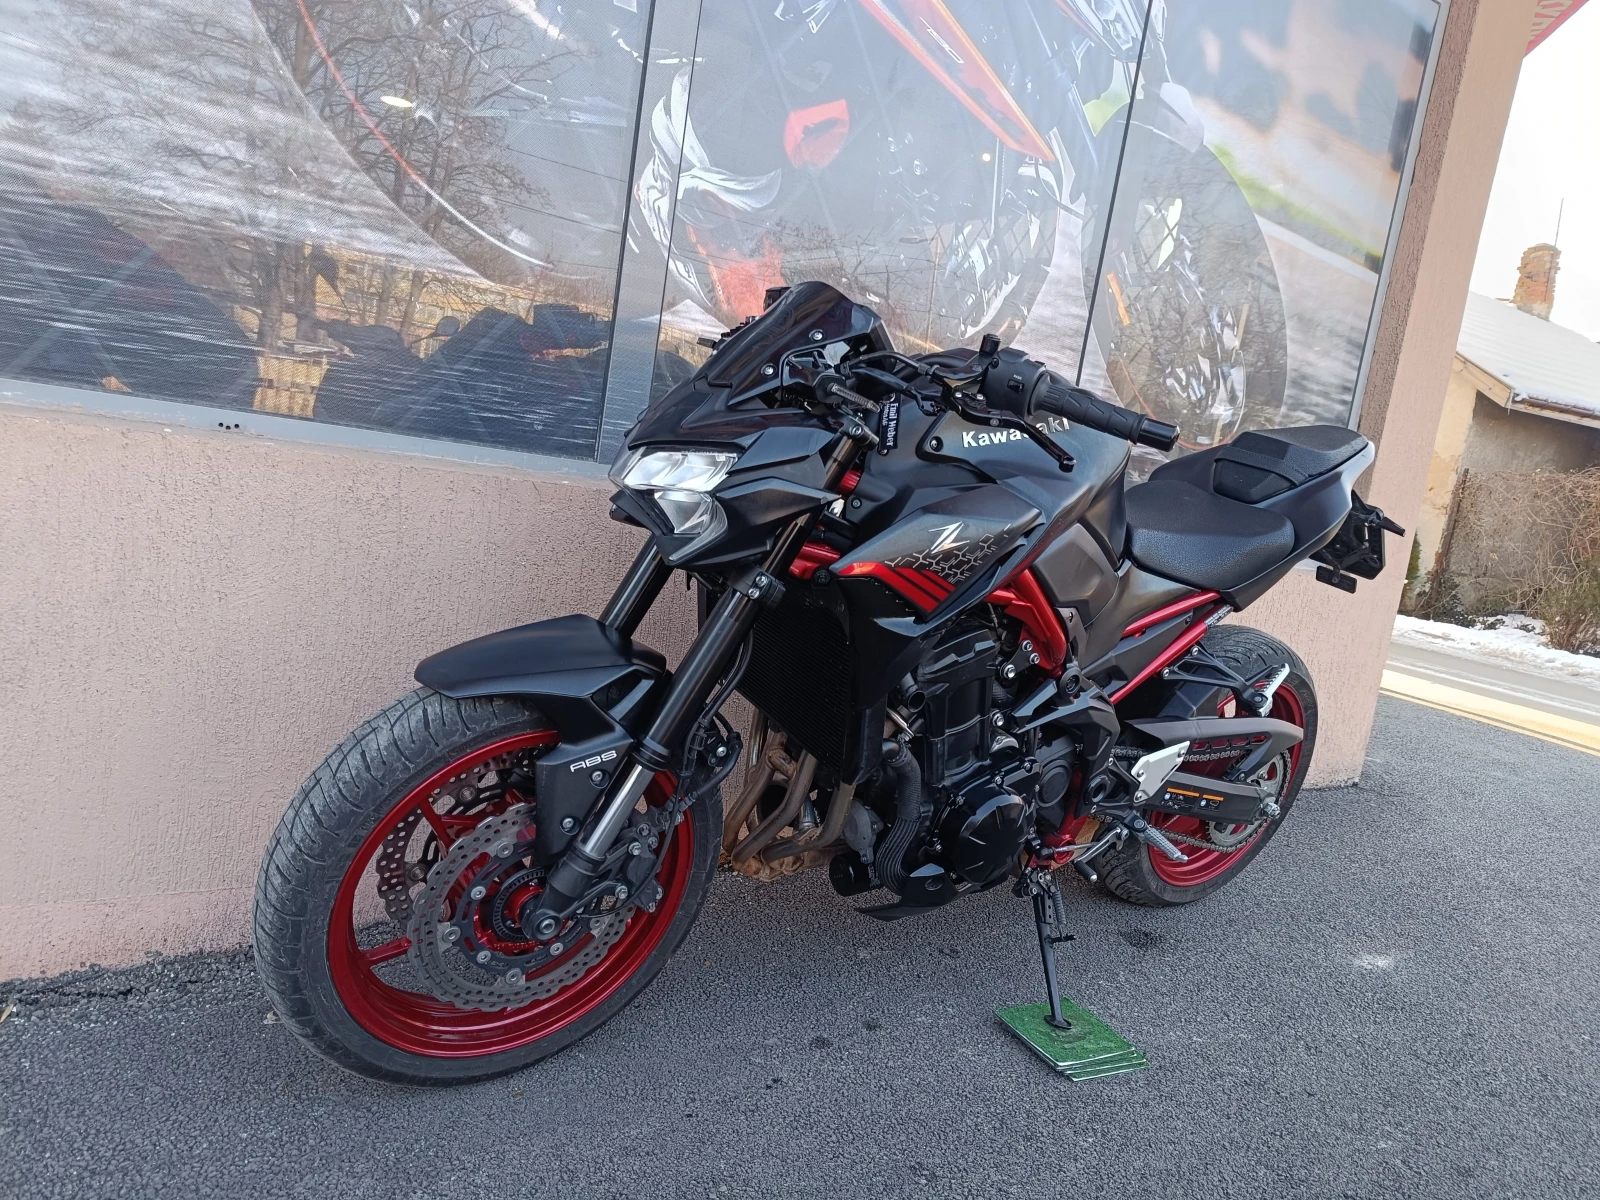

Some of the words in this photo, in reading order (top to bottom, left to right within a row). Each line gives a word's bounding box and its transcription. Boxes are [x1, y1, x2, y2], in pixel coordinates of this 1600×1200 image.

[889, 402, 899, 419] Emil
[886, 420, 897, 447] Weber
[962, 416, 1070, 448] Kawaaki
[570, 750, 617, 773] ABS
